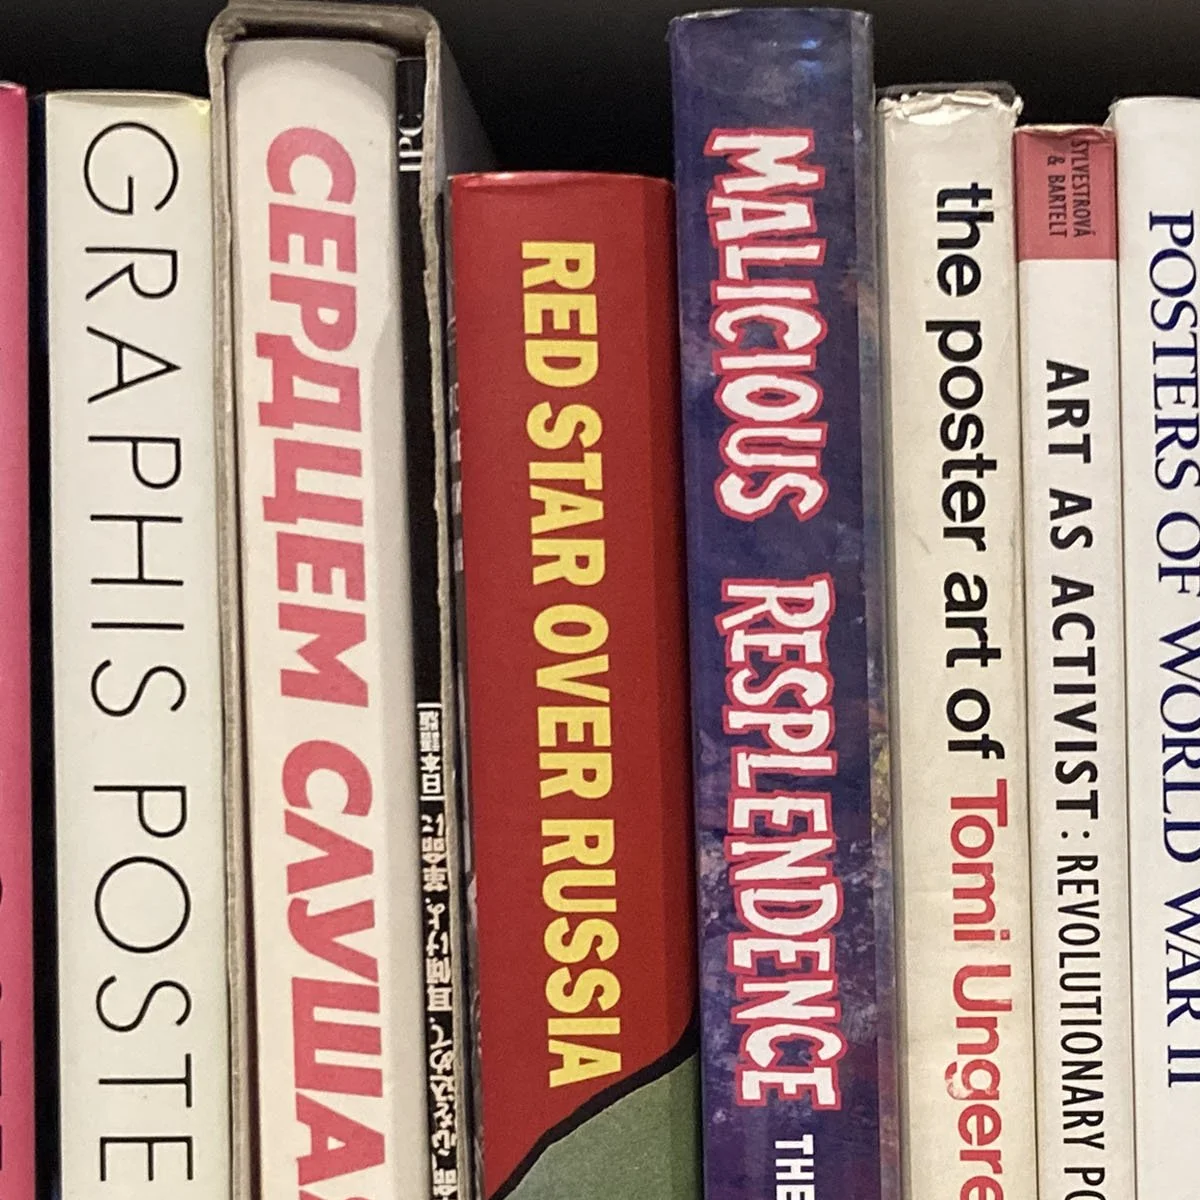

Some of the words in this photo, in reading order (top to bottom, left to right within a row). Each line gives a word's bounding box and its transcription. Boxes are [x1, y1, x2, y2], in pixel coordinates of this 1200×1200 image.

[937, 183, 994, 297] the
[1047, 155, 1063, 167] &
[1048, 175, 1067, 237] BARTELT
[522, 242, 598, 387] RED
[705, 128, 827, 522] MALICIOUS
[84, 122, 186, 717] GRAPHIS
[255, 127, 368, 707] СЕРДЦЕМ
[527, 402, 605, 585] STAR
[926, 320, 997, 551] poster
[1047, 360, 1091, 463] ART
[1049, 488, 1093, 549] AS
[534, 604, 612, 798] OVER
[944, 572, 1001, 668] art
[946, 699, 1005, 759] of
[716, 573, 848, 1110] RESPLENDENCE
[950, 779, 1010, 941] Tomi
[542, 819, 623, 1088] RUSSIA
[1057, 856, 1104, 1149] REVOLUTIONARY
